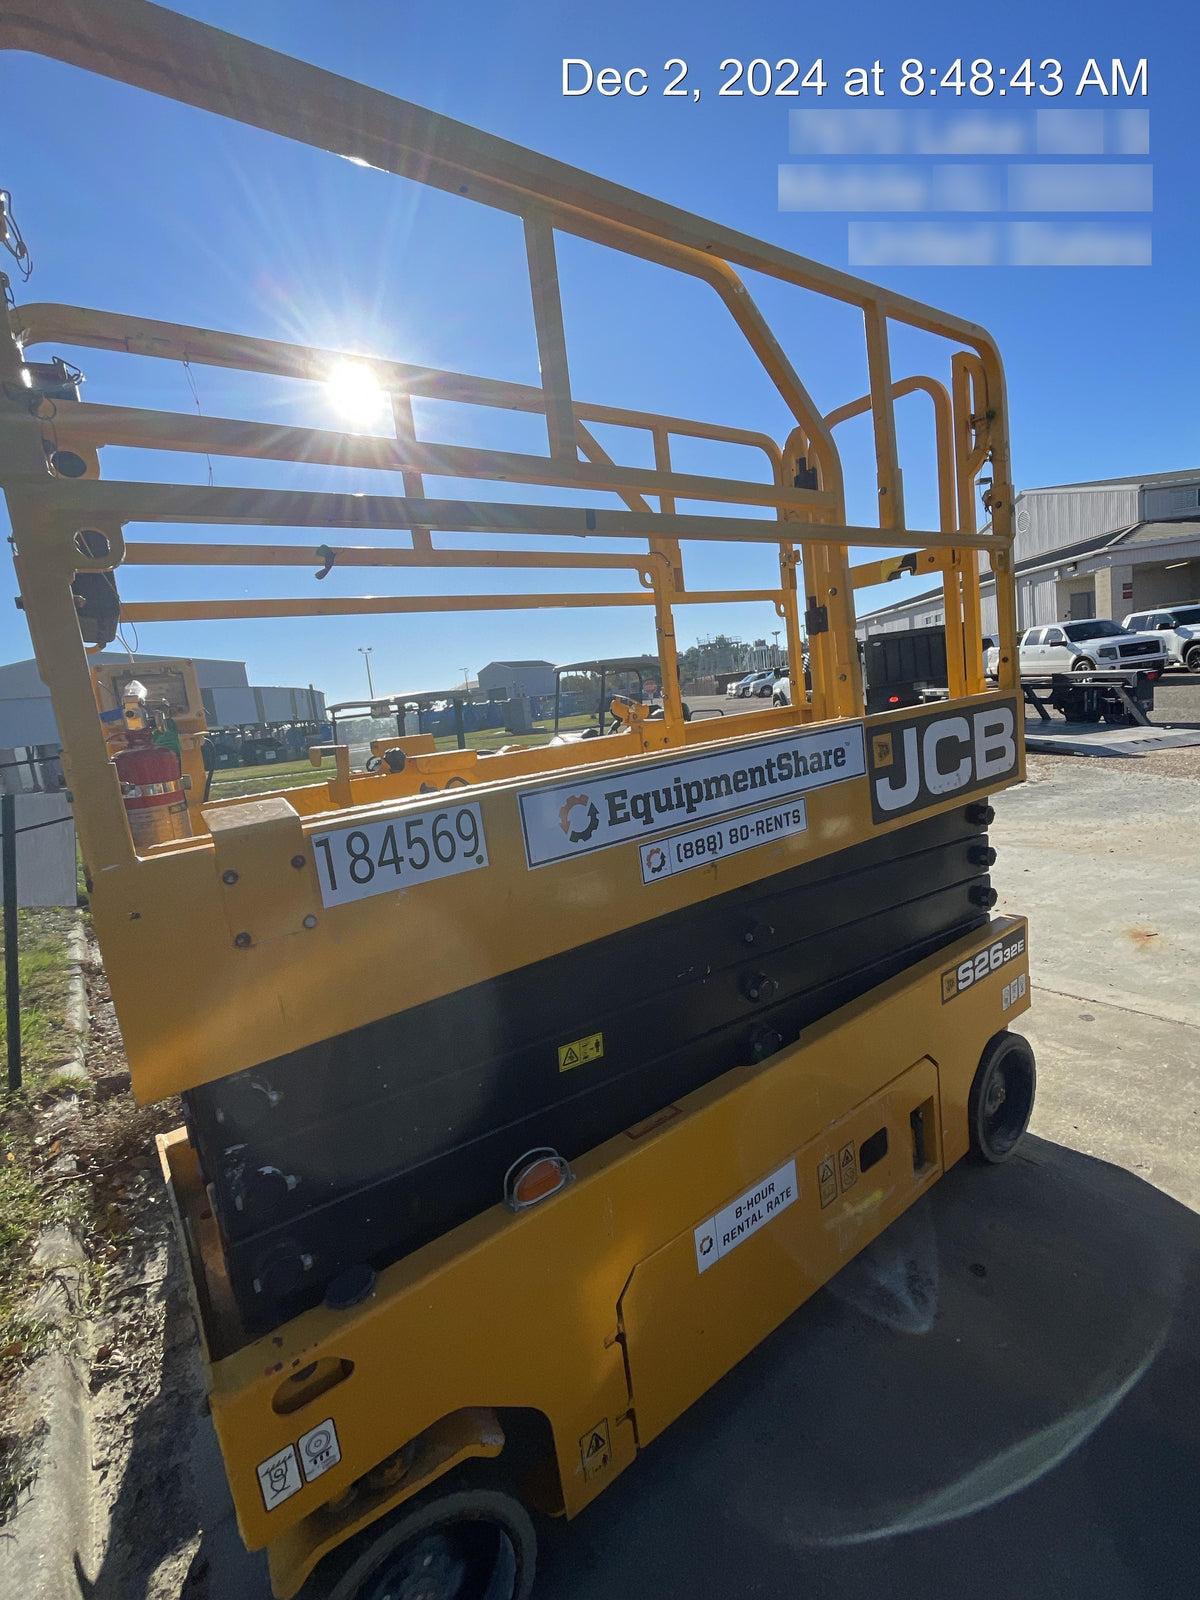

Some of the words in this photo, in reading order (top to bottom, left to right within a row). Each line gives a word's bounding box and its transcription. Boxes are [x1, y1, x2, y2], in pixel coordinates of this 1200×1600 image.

[604, 746, 847, 827] EquipmentShare
[875, 707, 1016, 811] JCB
[676, 831, 723, 863] (888)
[728, 808, 801, 845] 80-RENTS
[722, 1212, 764, 1247] RENTAL
[766, 1186, 793, 1214] RATE
[734, 1182, 776, 1220] 8-HOUR
